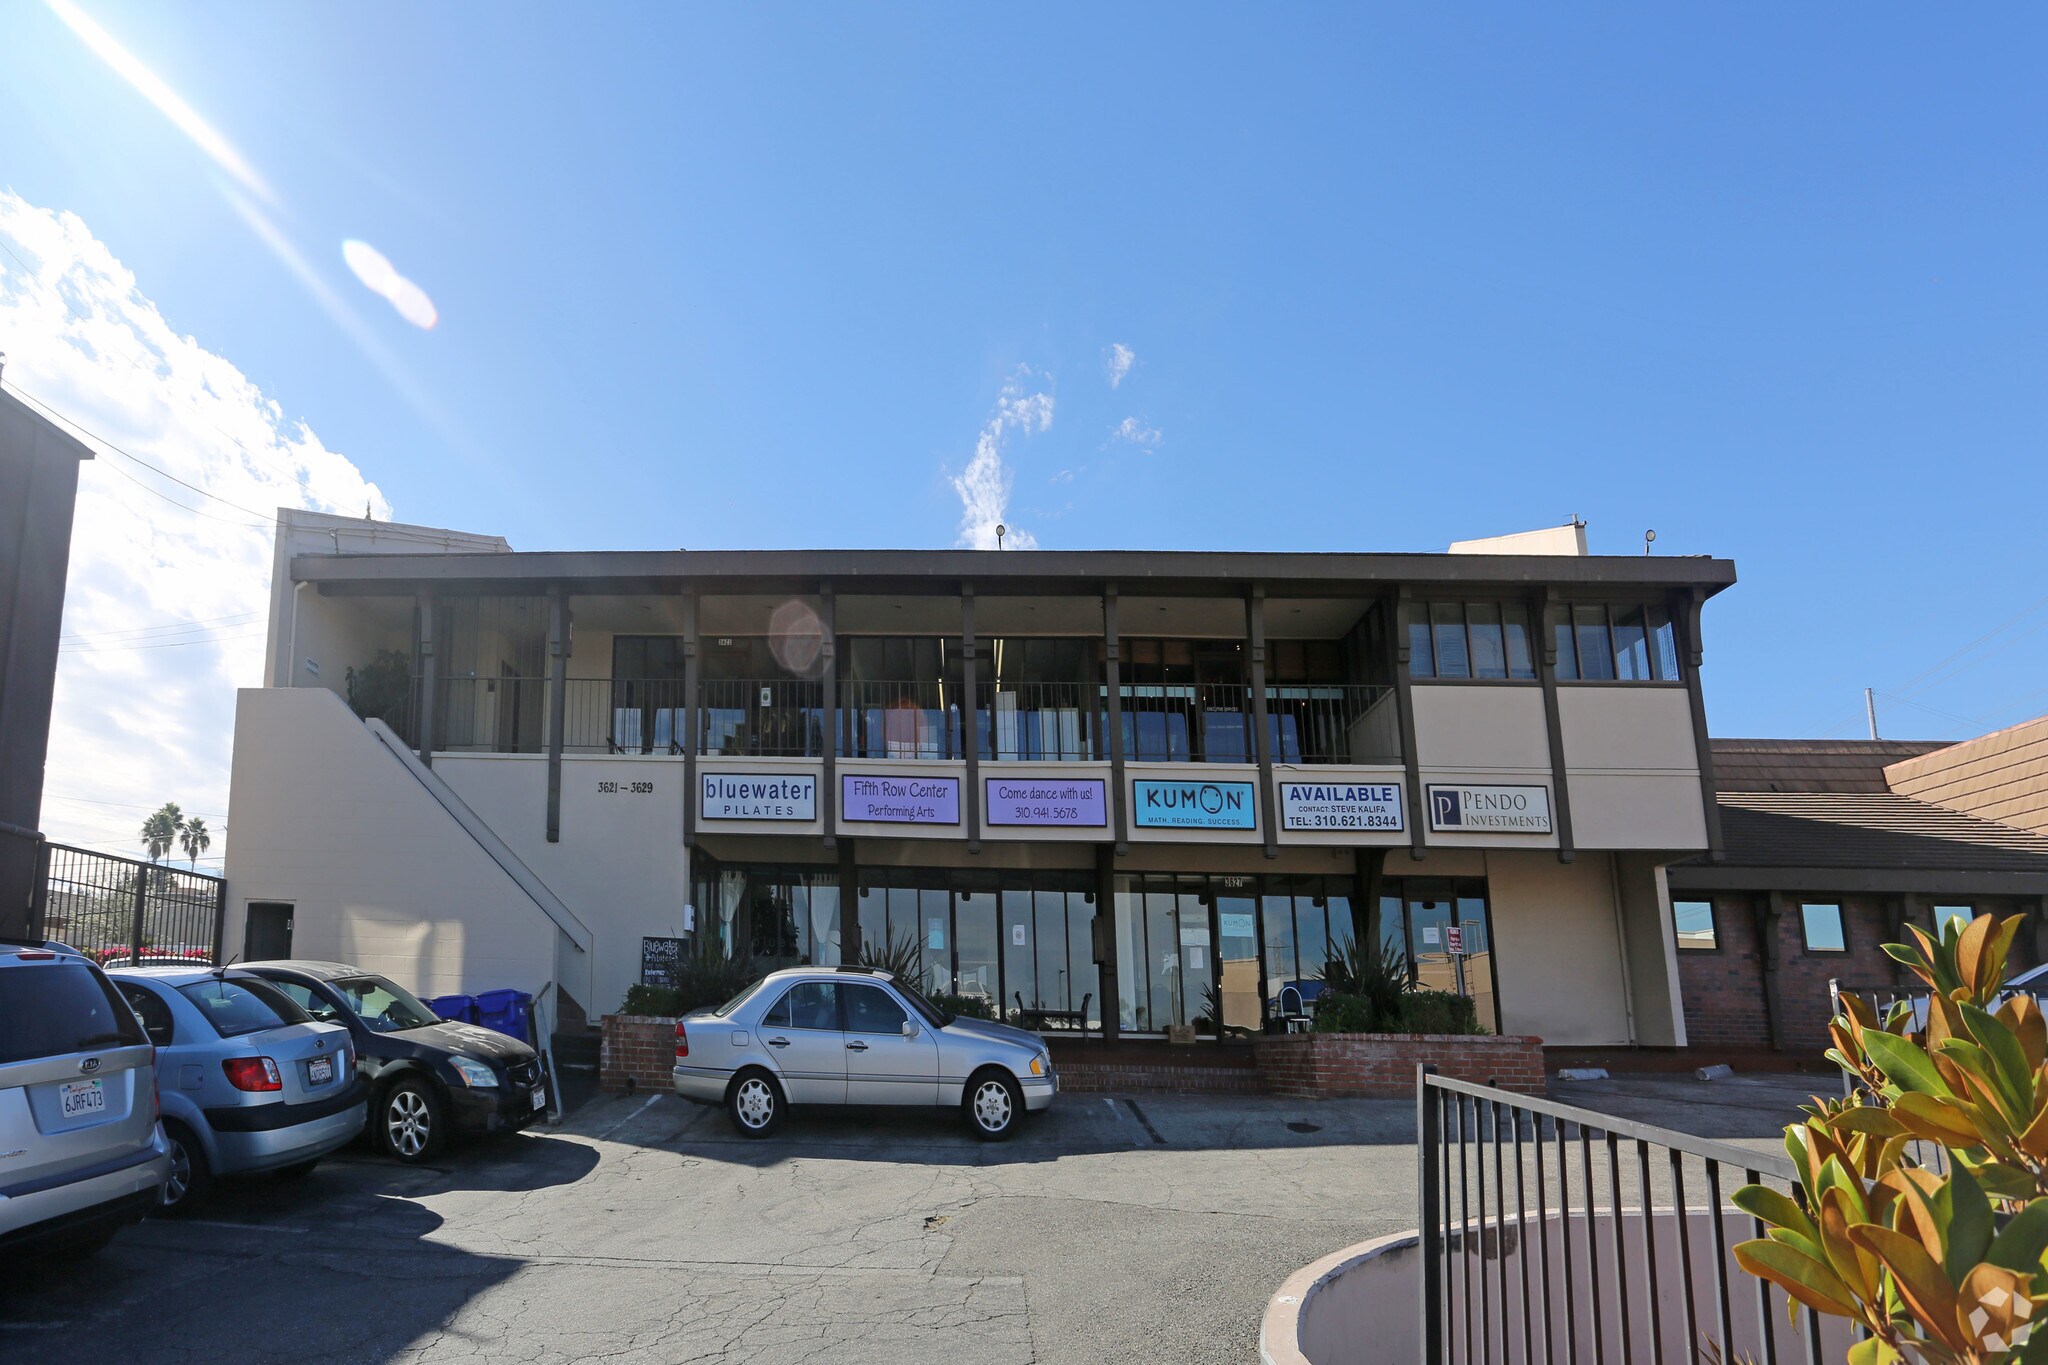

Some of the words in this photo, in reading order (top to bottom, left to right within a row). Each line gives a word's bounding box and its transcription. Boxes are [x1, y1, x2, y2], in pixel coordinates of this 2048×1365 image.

[598, 781, 618, 794] 3621
[631, 781, 653, 794] 3629
[706, 778, 812, 800] bluewater
[854, 780, 878, 796] Fifth
[881, 781, 906, 797] Row
[909, 782, 948, 798] Center
[999, 786, 1028, 800] Come
[1029, 787, 1058, 800] dance
[1059, 787, 1079, 800] with
[1080, 787, 1093, 800] us!
[1290, 786, 1393, 802] AVAILABLE
[1463, 790, 1527, 811] PENDO
[724, 805, 793, 816] PILATES
[867, 804, 915, 821] Performing
[916, 806, 935, 818] Arts
[1015, 806, 1078, 819] 310.941.5678
[1298, 805, 1330, 813] CONTACT:
[1331, 805, 1356, 813] STEVE
[1358, 805, 1386, 813] KALIFA
[1289, 816, 1312, 826] TEL:
[1314, 815, 1397, 827] 310.621.8344
[1465, 813, 1548, 828] INVESTMENTS
[1224, 876, 1243, 888] 3627
[65, 1090, 103, 1112] 6JRF473
